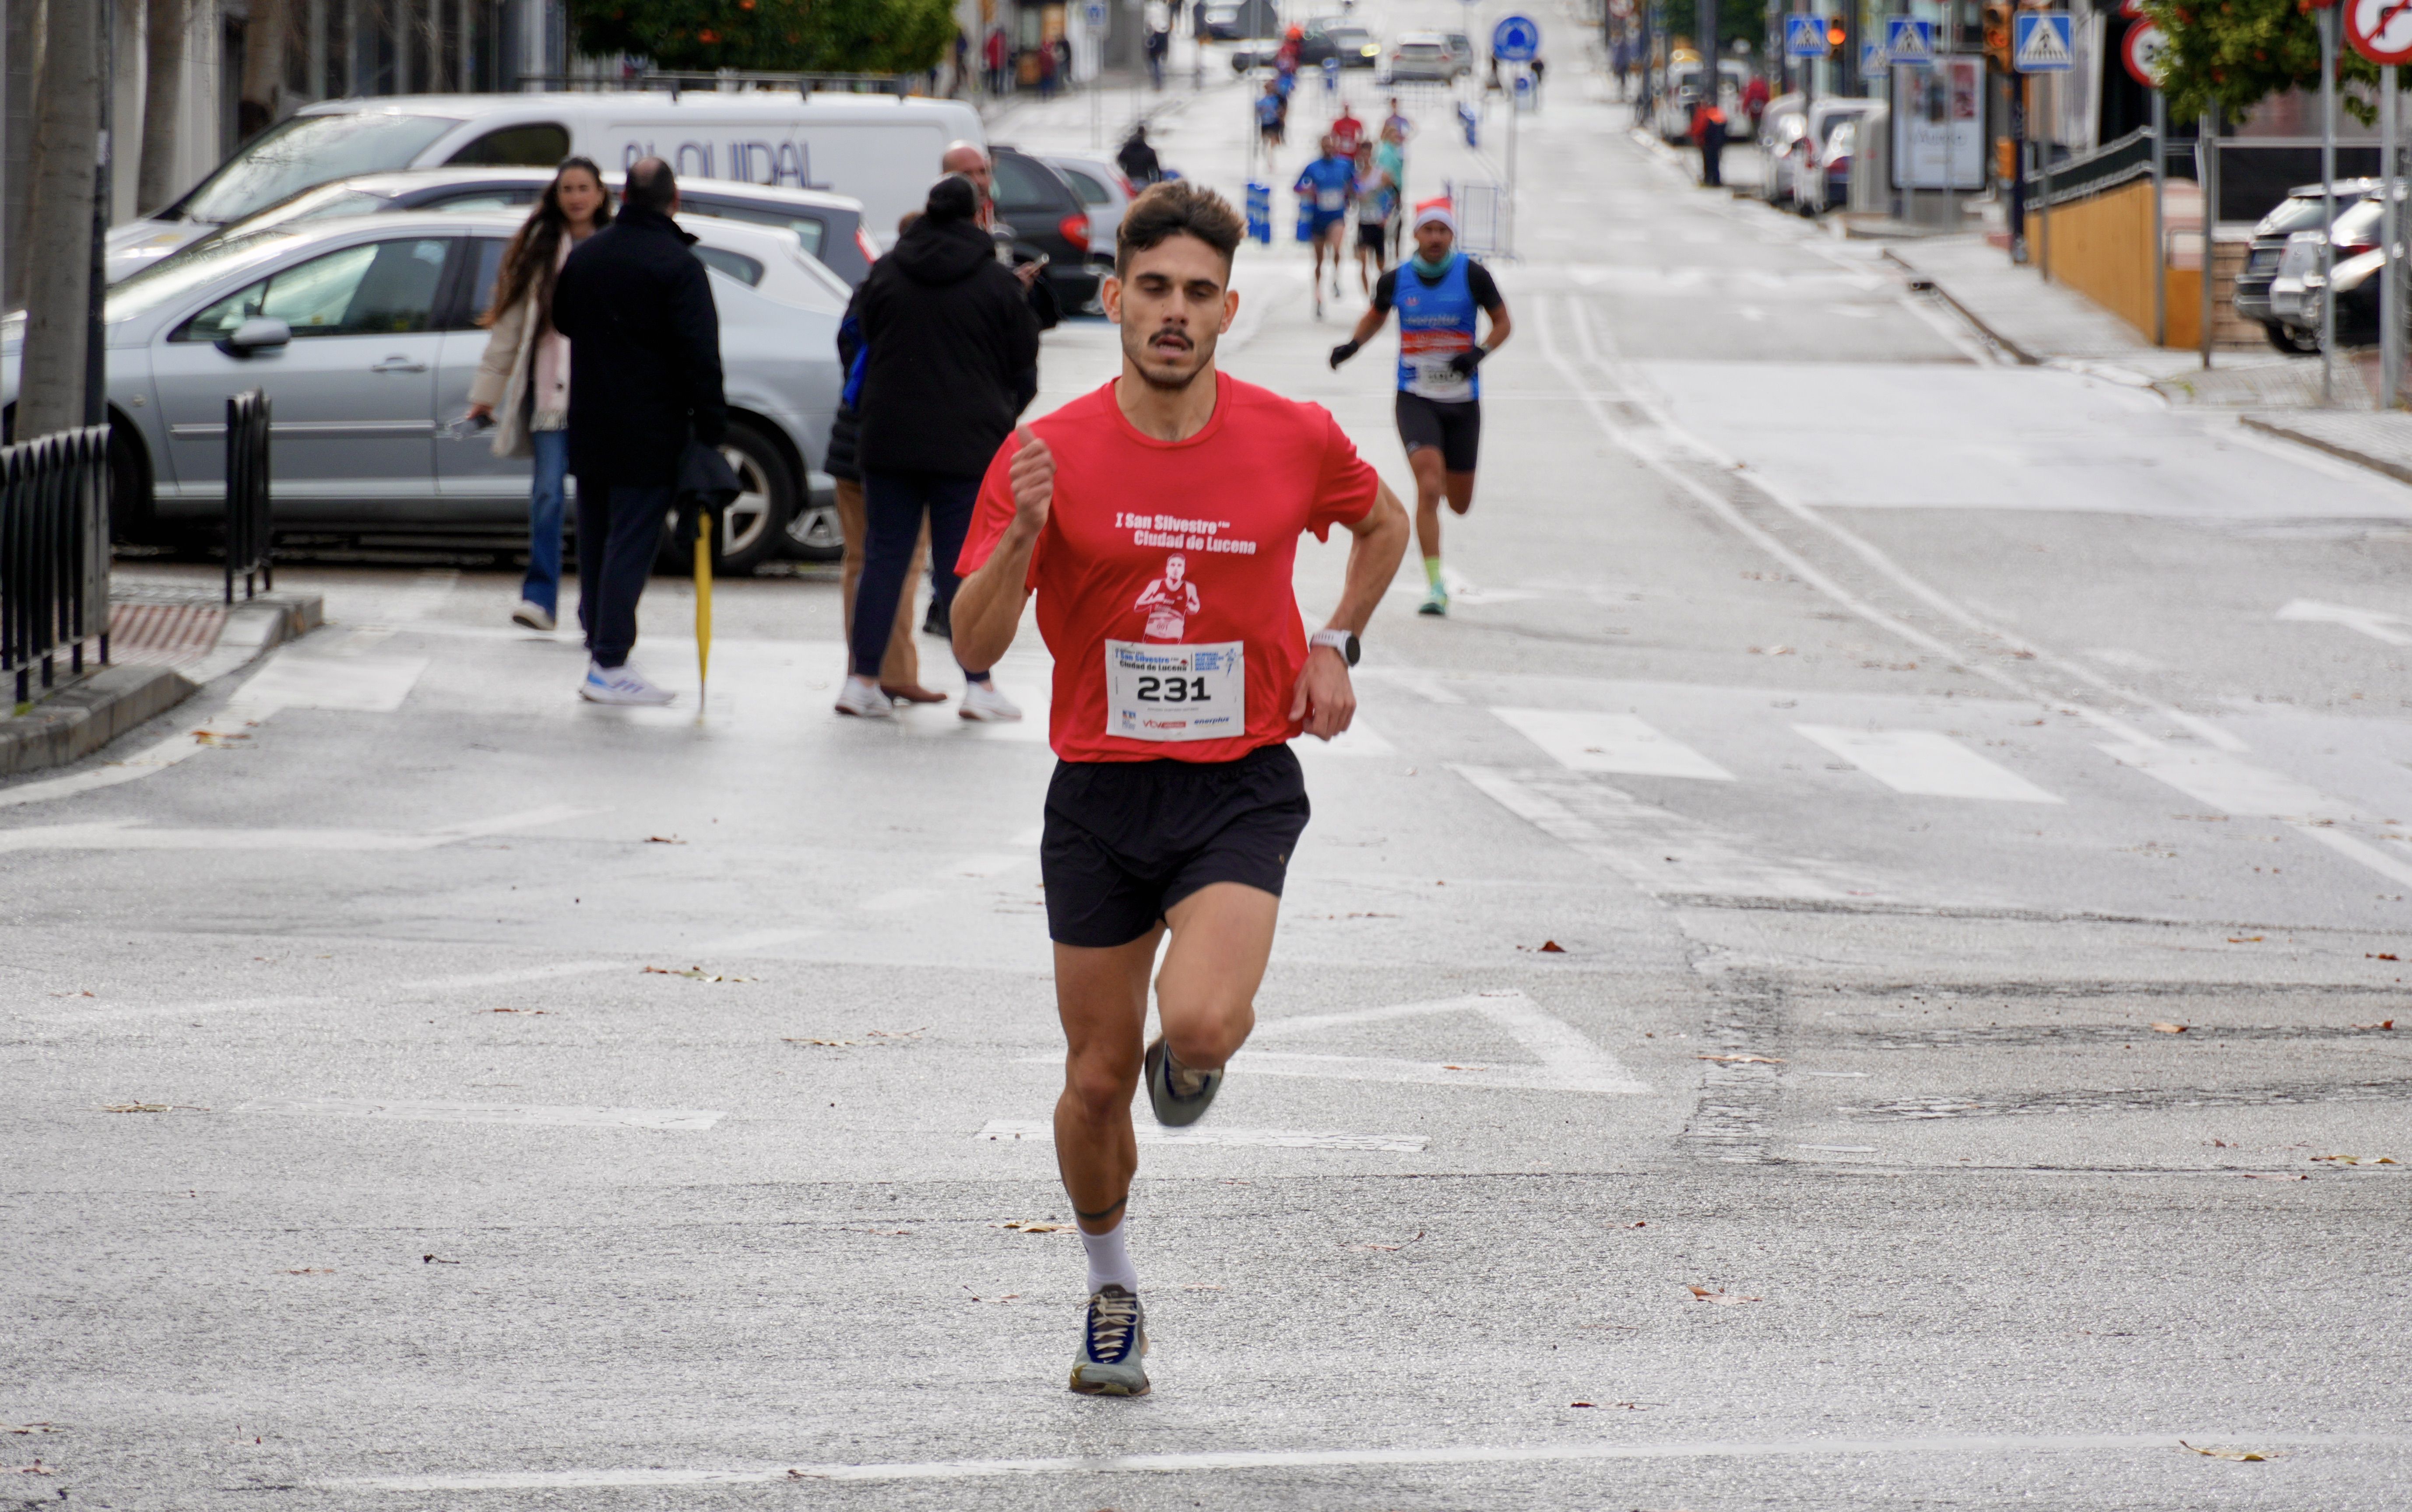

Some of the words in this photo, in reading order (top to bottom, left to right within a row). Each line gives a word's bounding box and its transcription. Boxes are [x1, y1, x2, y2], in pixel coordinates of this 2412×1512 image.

[1125, 512, 1152, 530] San
[1154, 514, 1217, 535] Silvestre
[1134, 529, 1185, 549] Ciudad
[1186, 534, 1204, 551] de
[1206, 535, 1257, 555] Lucena
[1120, 660, 1145, 670] Ciudad
[1158, 663, 1187, 672] Lucena
[1138, 676, 1211, 702] 231
